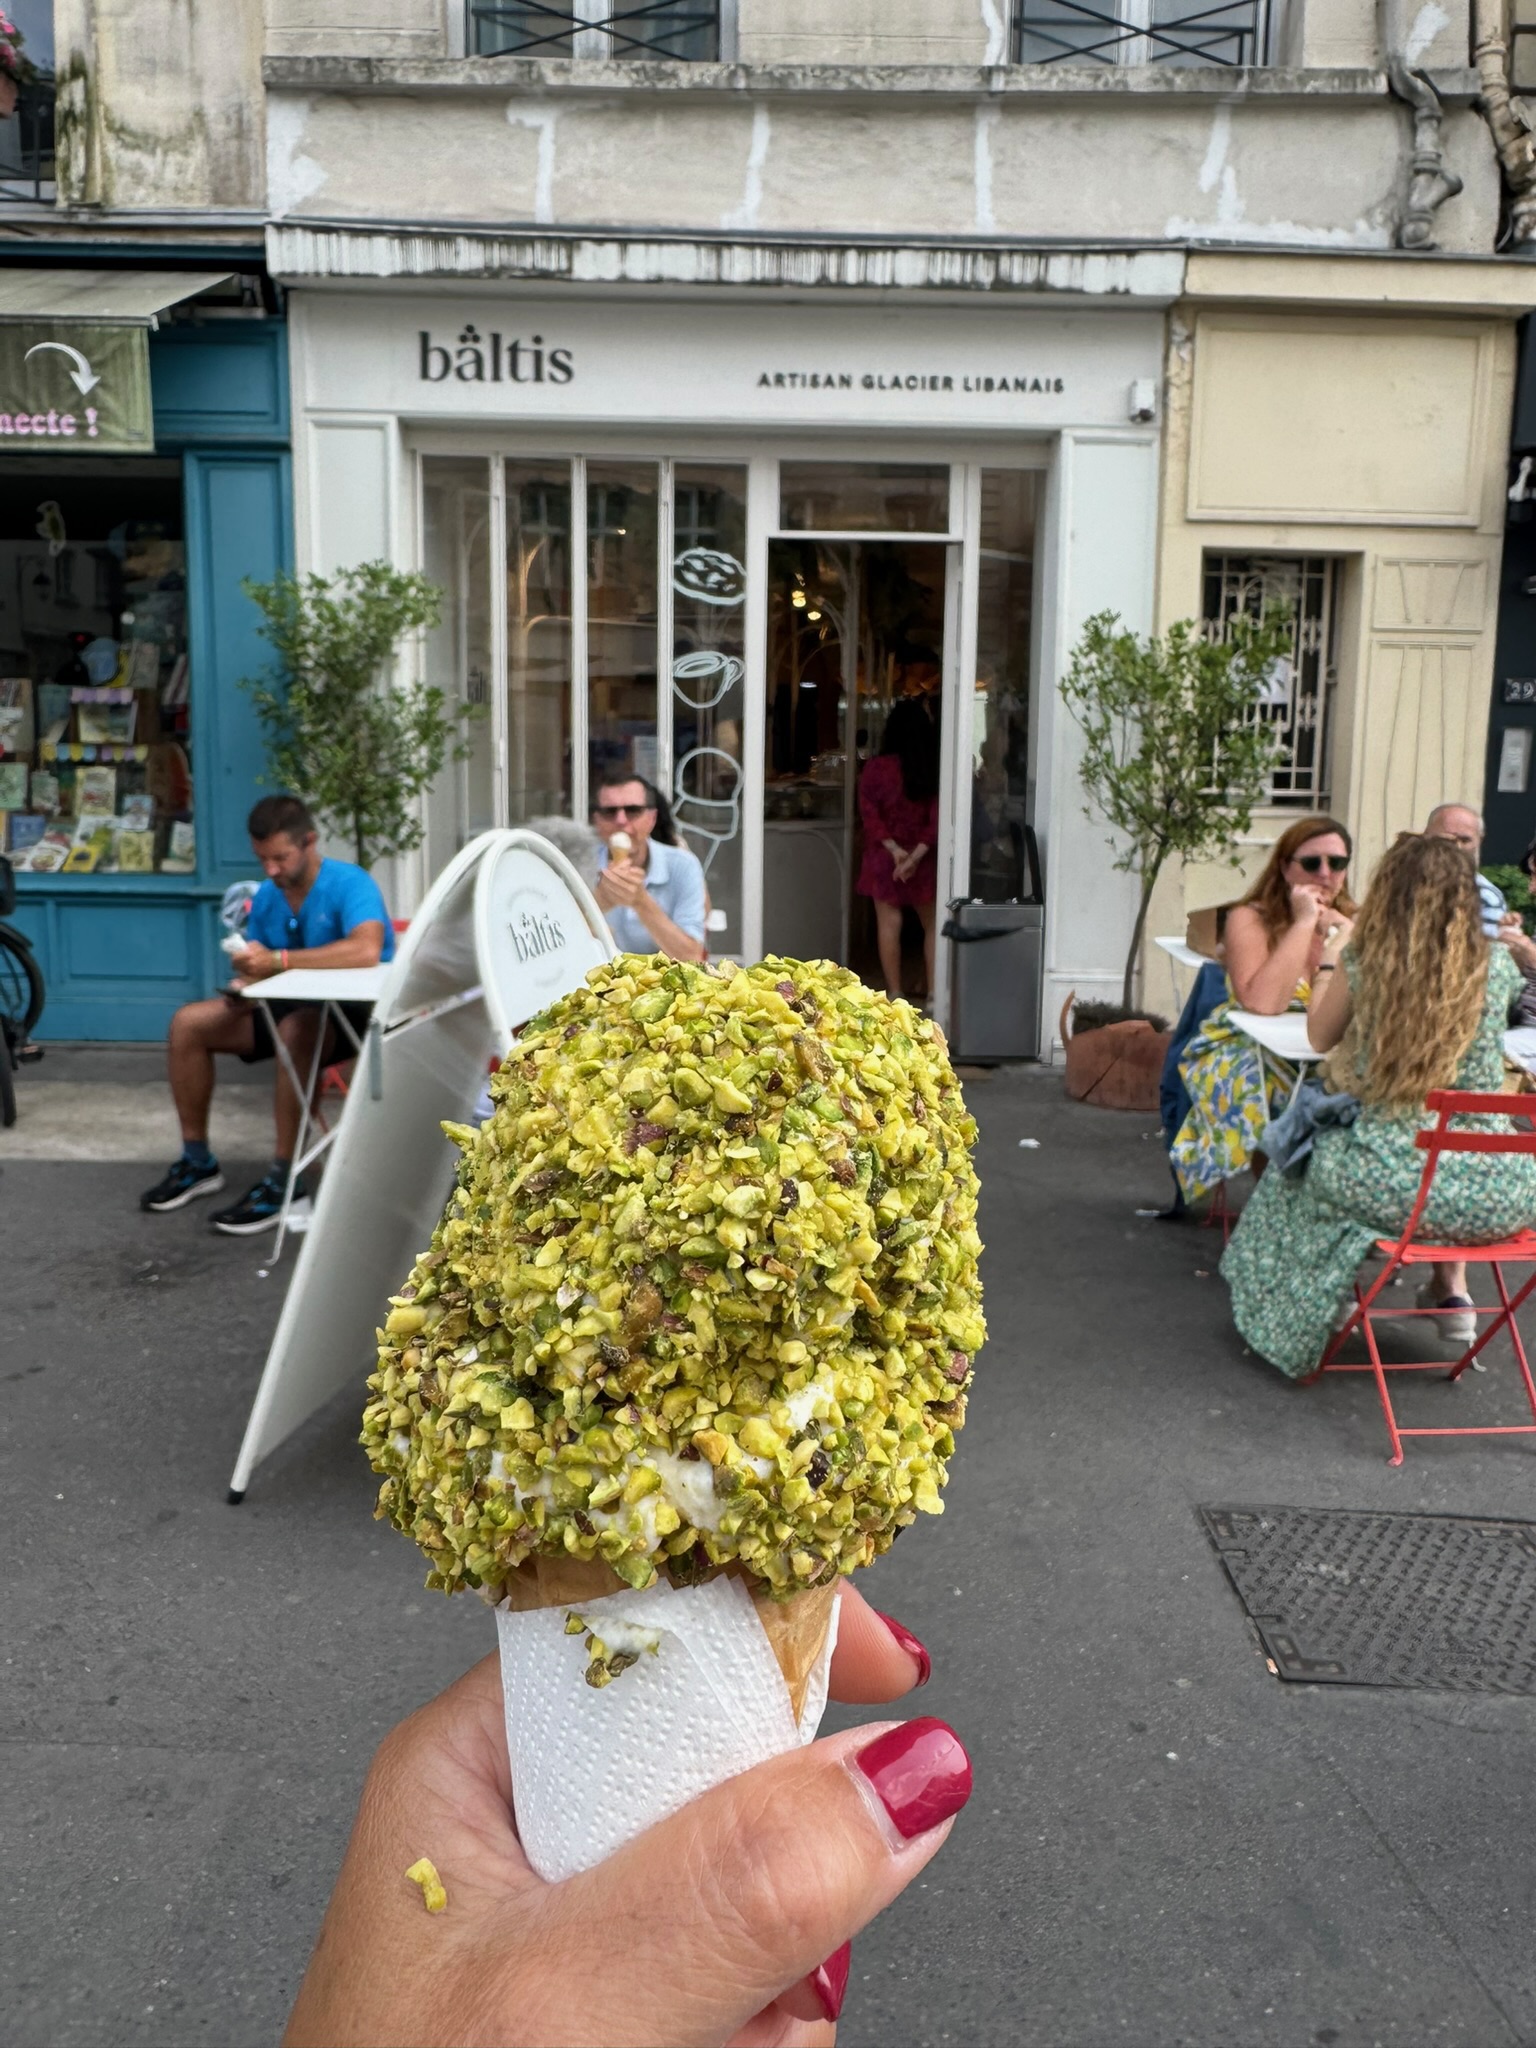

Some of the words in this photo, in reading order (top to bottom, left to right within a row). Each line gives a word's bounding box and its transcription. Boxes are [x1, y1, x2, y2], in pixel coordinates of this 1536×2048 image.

[757, 372, 852, 389] ARTISAN
[860, 375, 954, 391] GLACIER
[962, 377, 1065, 394] LIBANAIS
